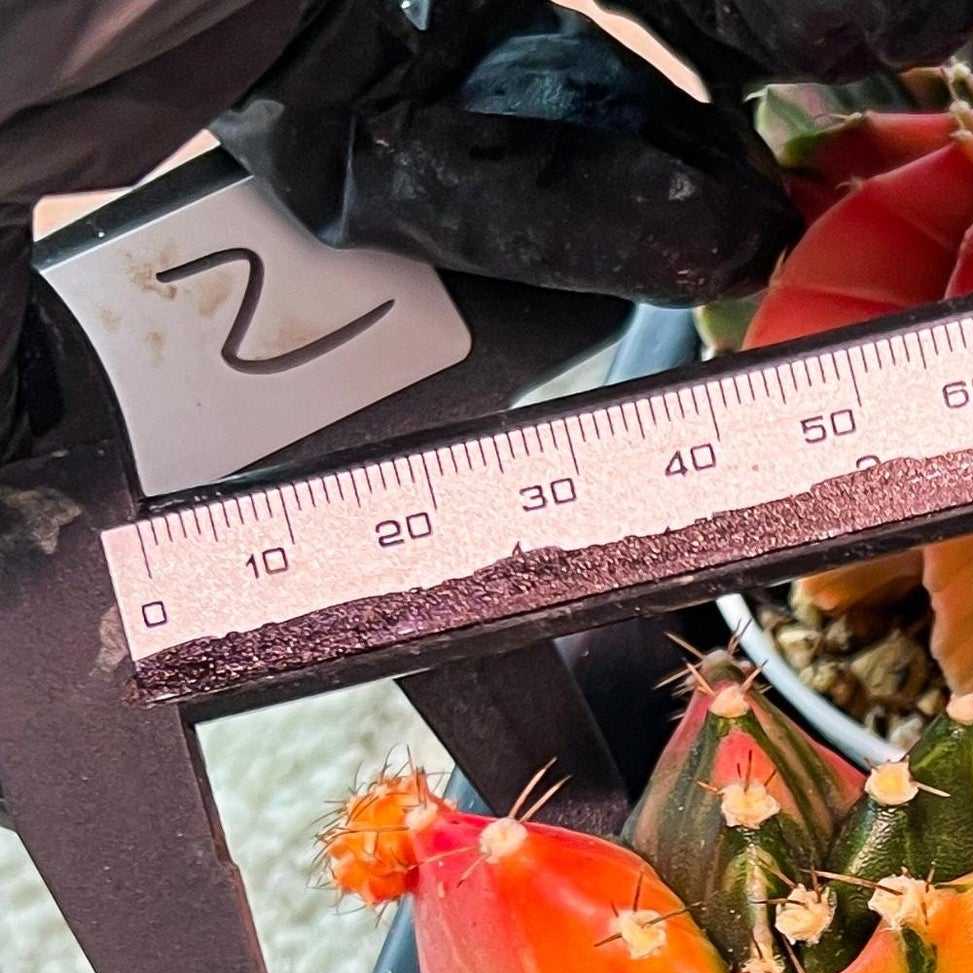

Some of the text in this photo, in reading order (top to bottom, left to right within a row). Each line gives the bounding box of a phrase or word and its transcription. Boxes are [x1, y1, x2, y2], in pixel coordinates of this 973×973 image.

[141, 600, 168, 628] 0
[245, 546, 289, 579] 10
[374, 511, 433, 548] 20
[518, 476, 577, 512] 30
[664, 442, 717, 478] 40
[799, 408, 857, 444] 50
